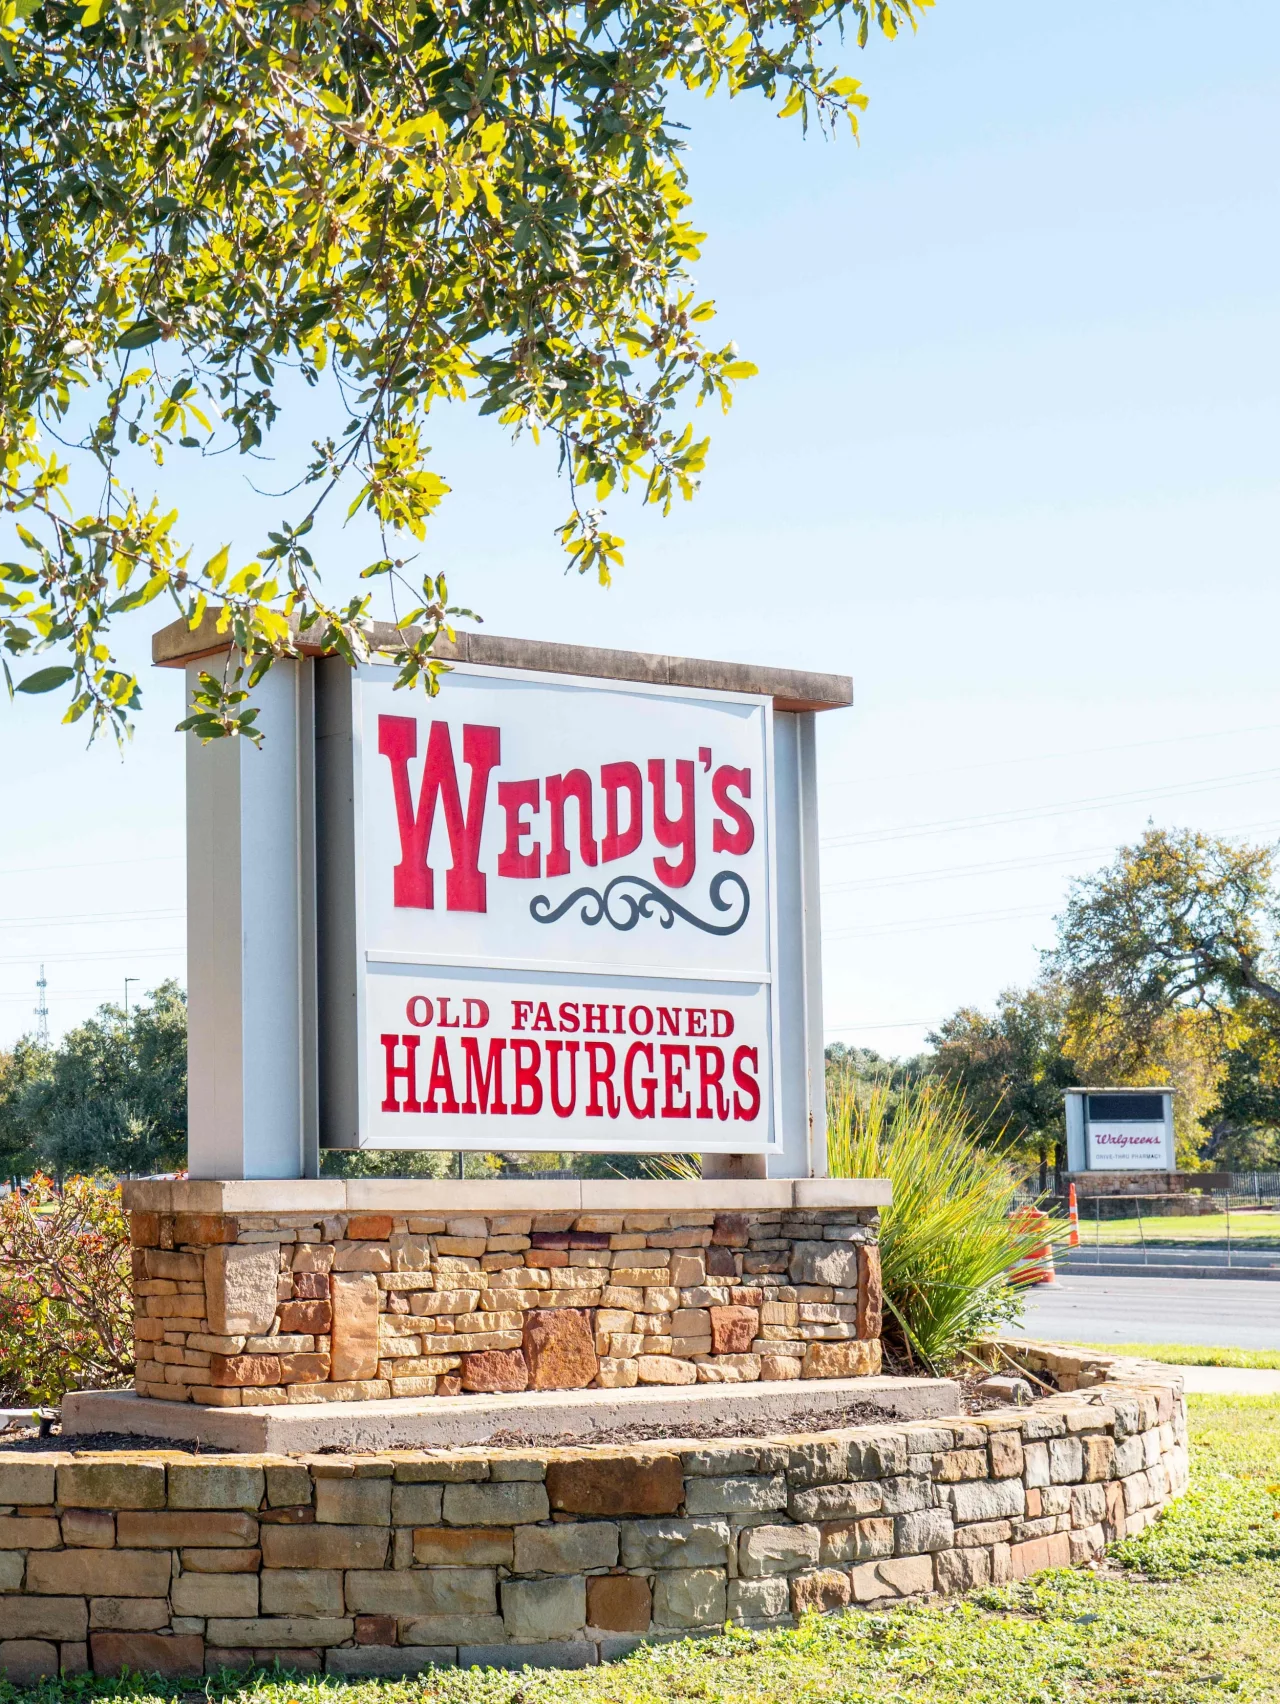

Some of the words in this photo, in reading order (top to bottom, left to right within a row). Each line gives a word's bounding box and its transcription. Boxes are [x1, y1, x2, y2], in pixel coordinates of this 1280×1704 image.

[405, 995, 490, 1029] OLD
[511, 1000, 735, 1038] FASHIONED
[380, 1033, 762, 1122] HAMBURGERS
[1095, 1134, 1161, 1148] Walgreens
